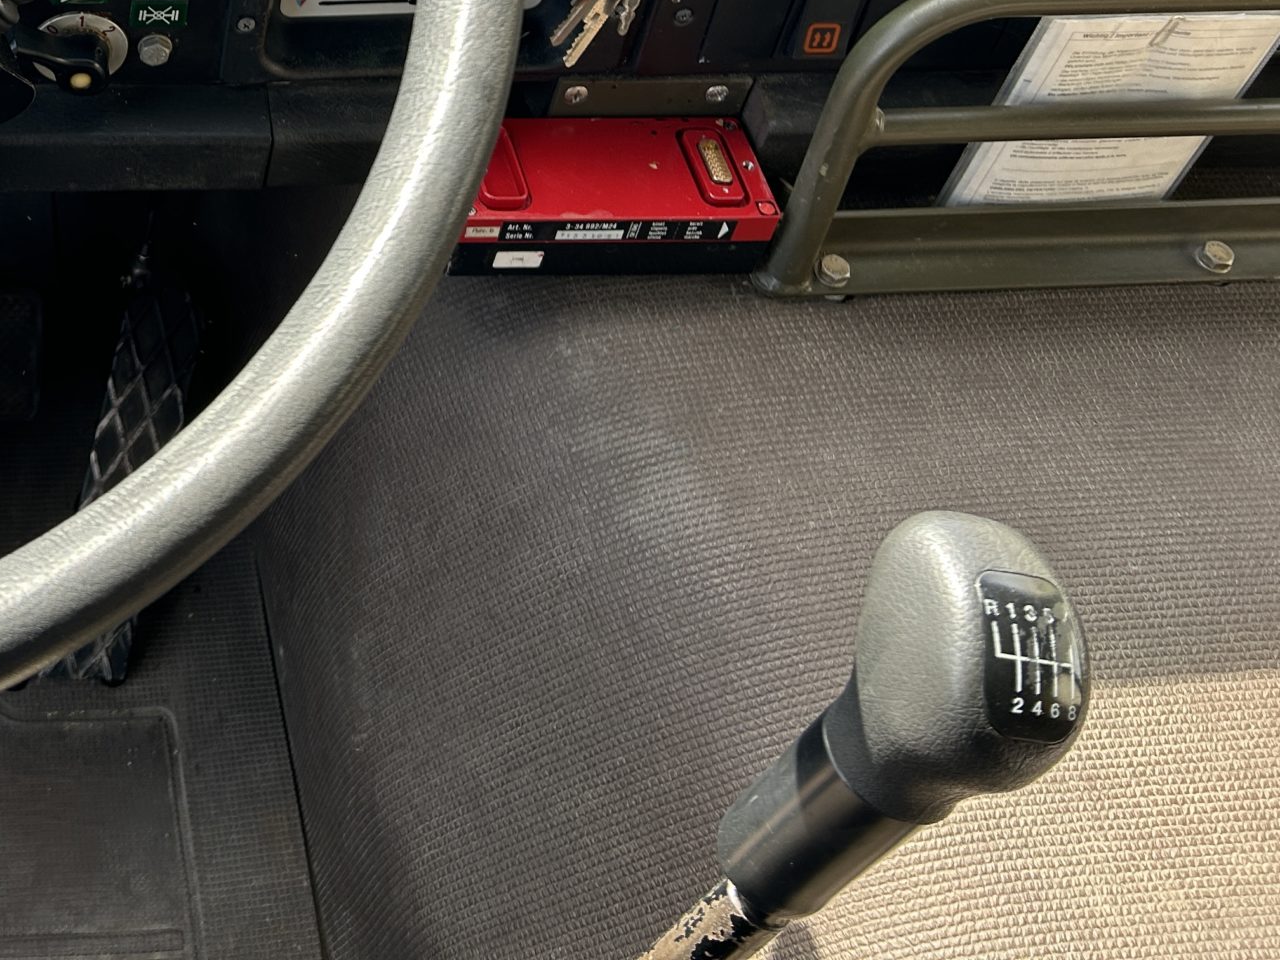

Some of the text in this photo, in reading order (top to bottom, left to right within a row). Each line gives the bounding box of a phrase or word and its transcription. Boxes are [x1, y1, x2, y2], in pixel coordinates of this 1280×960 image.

[79, 16, 85, 27] 1
[46, 25, 58, 34] 0
[102, 26, 116, 37] 2
[984, 599, 1000, 616] R
[1005, 603, 1016, 619] 1
[1023, 605, 1037, 622] 3
[1011, 697, 1024, 714] 2
[1032, 701, 1042, 716] 4
[1050, 703, 1060, 719] 6
[1068, 706, 1077, 721] 8
